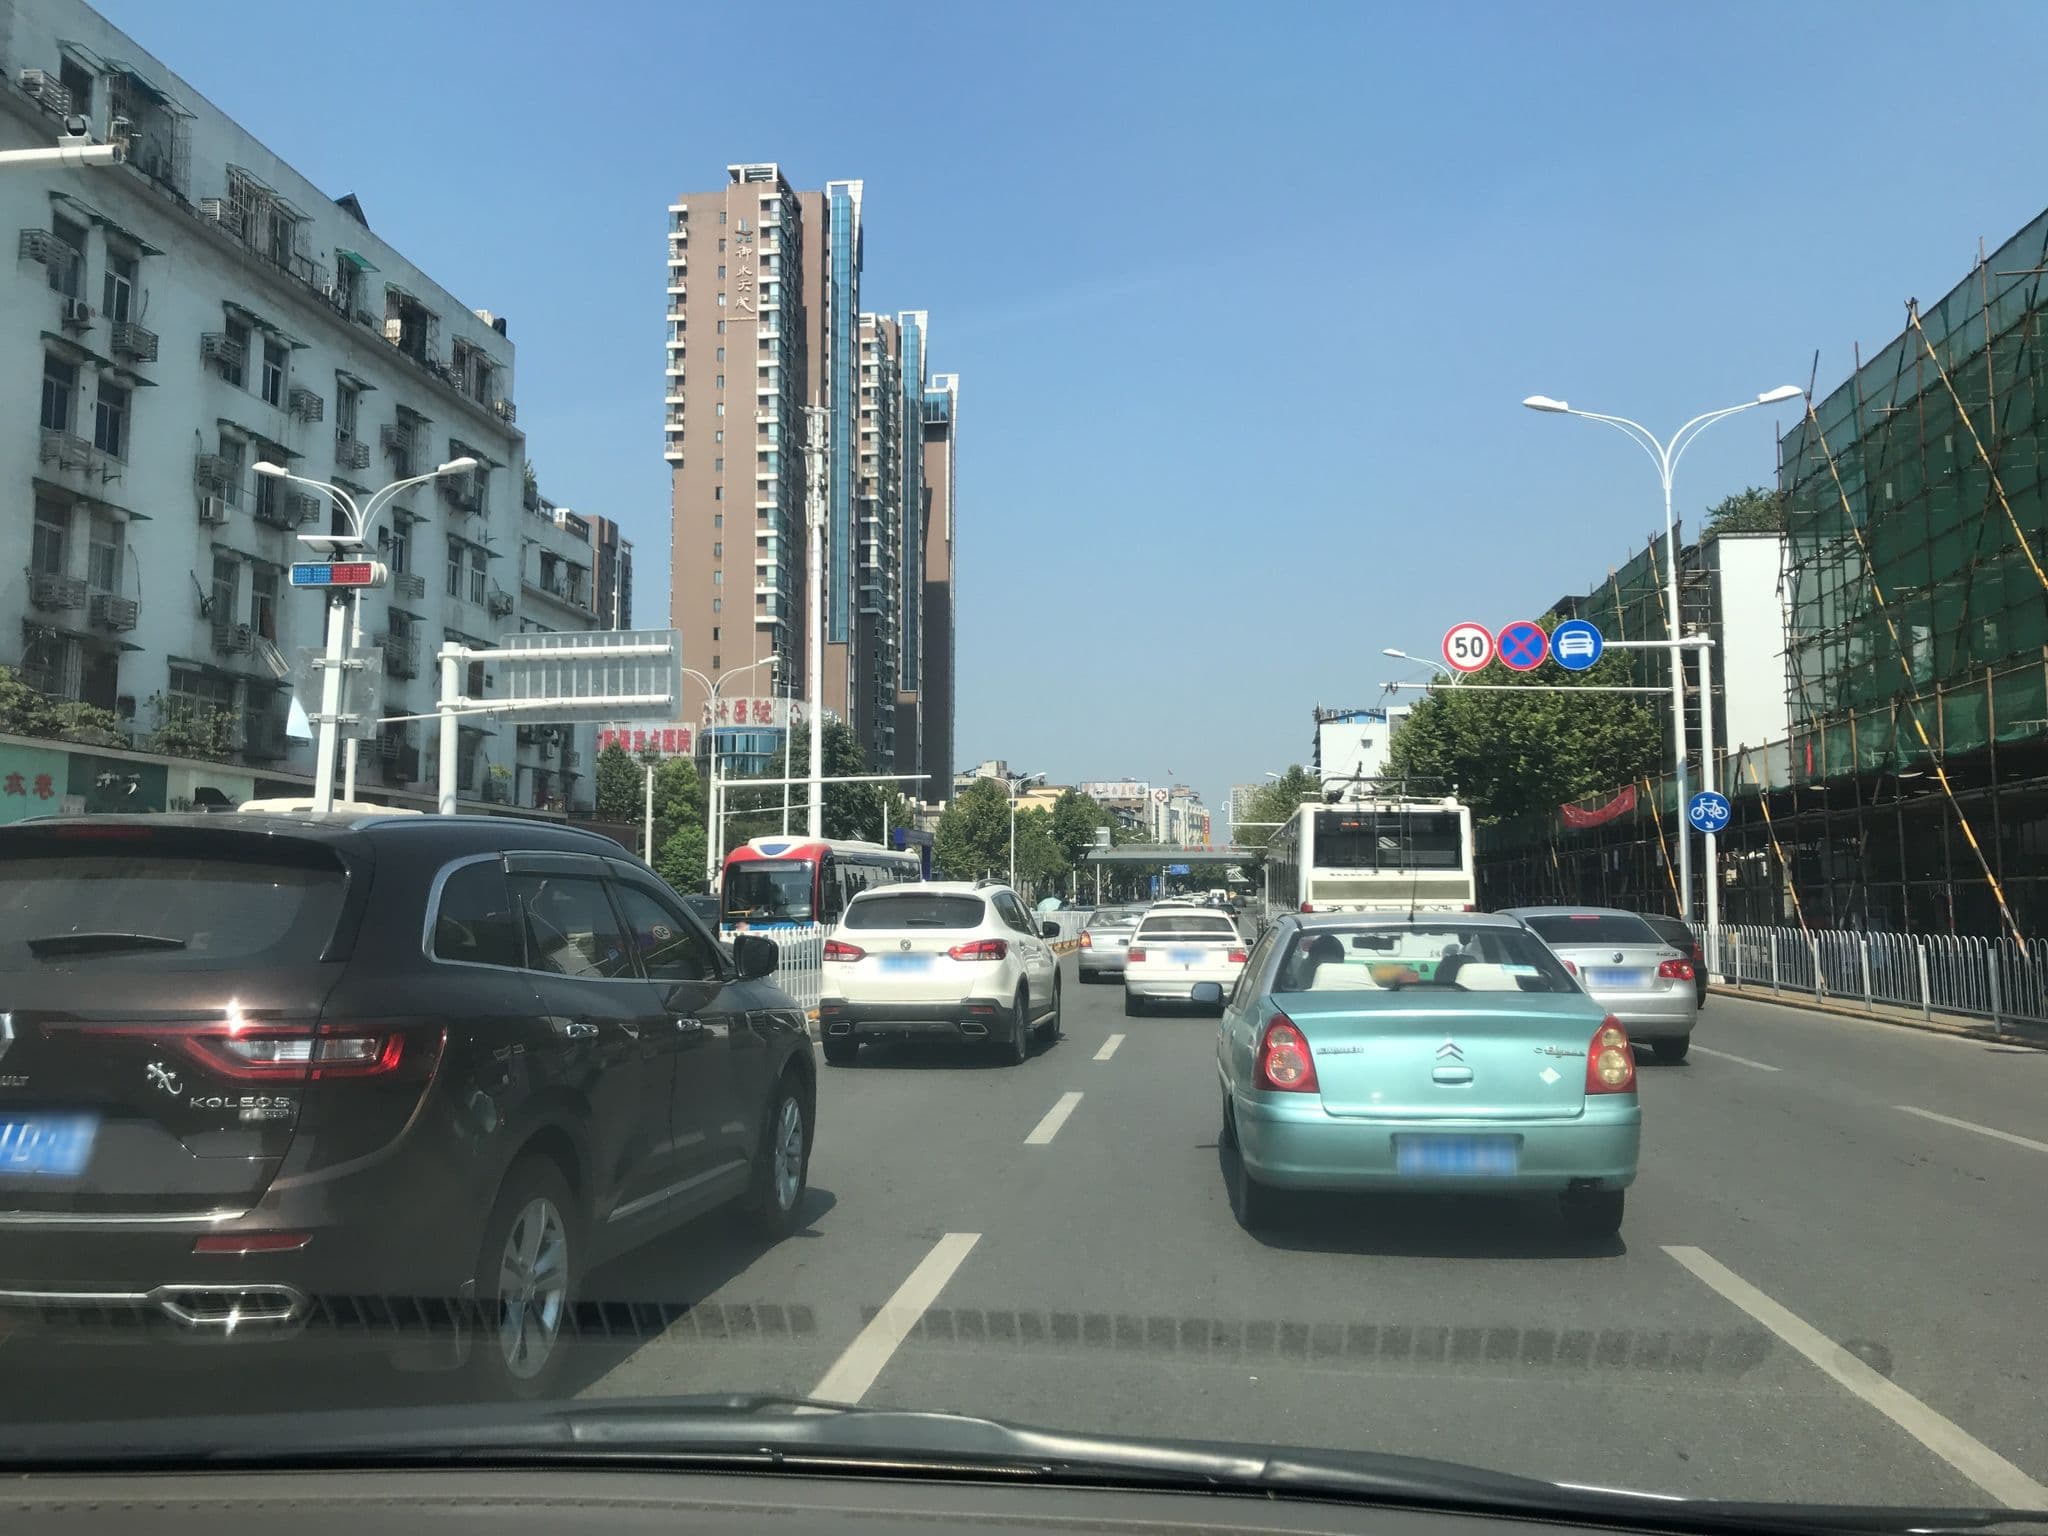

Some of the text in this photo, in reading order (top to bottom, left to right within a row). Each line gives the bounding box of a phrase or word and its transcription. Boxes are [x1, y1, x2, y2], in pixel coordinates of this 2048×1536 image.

[735, 245, 755, 313] 御水天成
[1455, 636, 1484, 658] 50
[190, 1096, 290, 1109] KOLEOS
